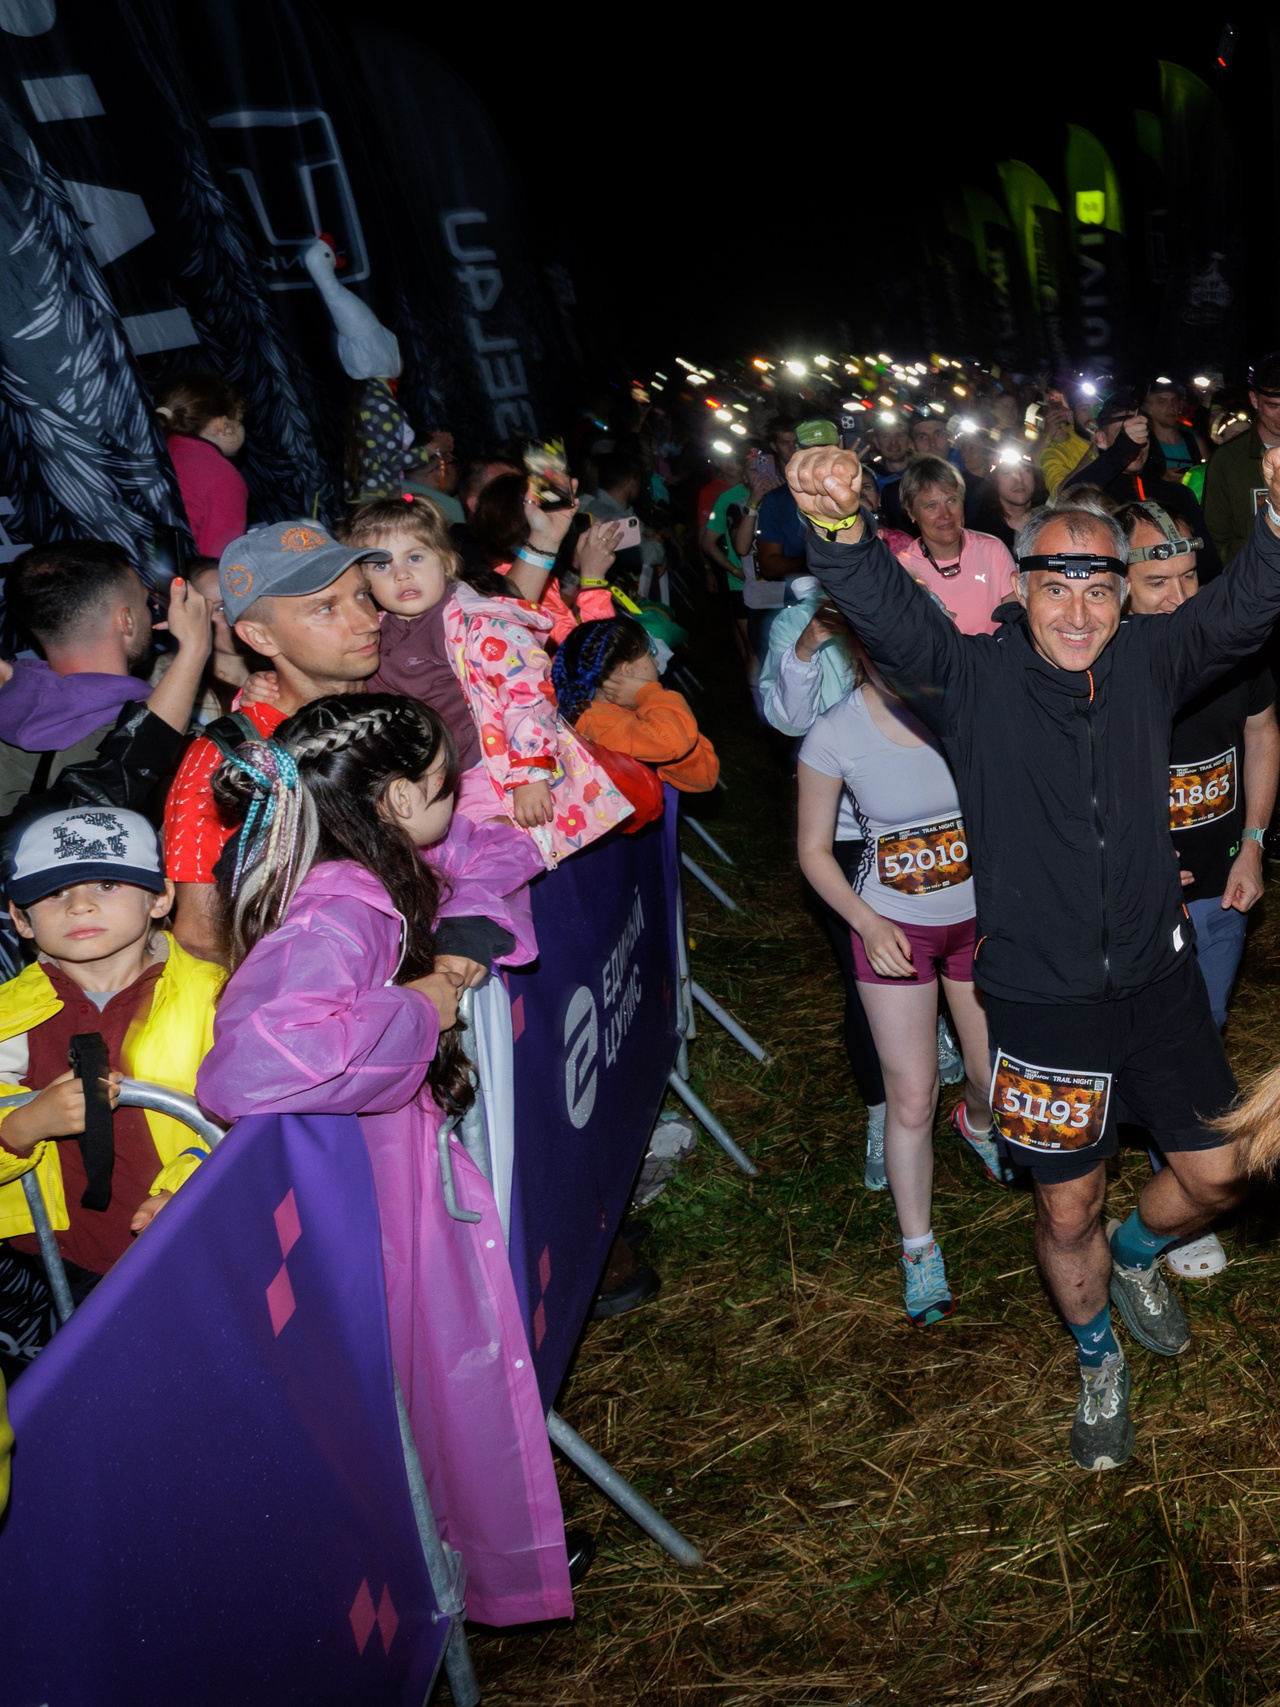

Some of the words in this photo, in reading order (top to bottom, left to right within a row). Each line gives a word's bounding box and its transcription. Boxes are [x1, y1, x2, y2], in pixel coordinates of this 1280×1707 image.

[922, 826, 938, 834] TRAIL
[938, 822, 955, 830] NIGHT
[884, 841, 968, 878] 52010
[602, 884, 645, 1010] ЕДИНЫЙ
[1052, 1075, 1071, 1084] TRAIL
[1073, 1078, 1093, 1086] NIGHT
[1003, 1087, 1091, 1128] 51193
